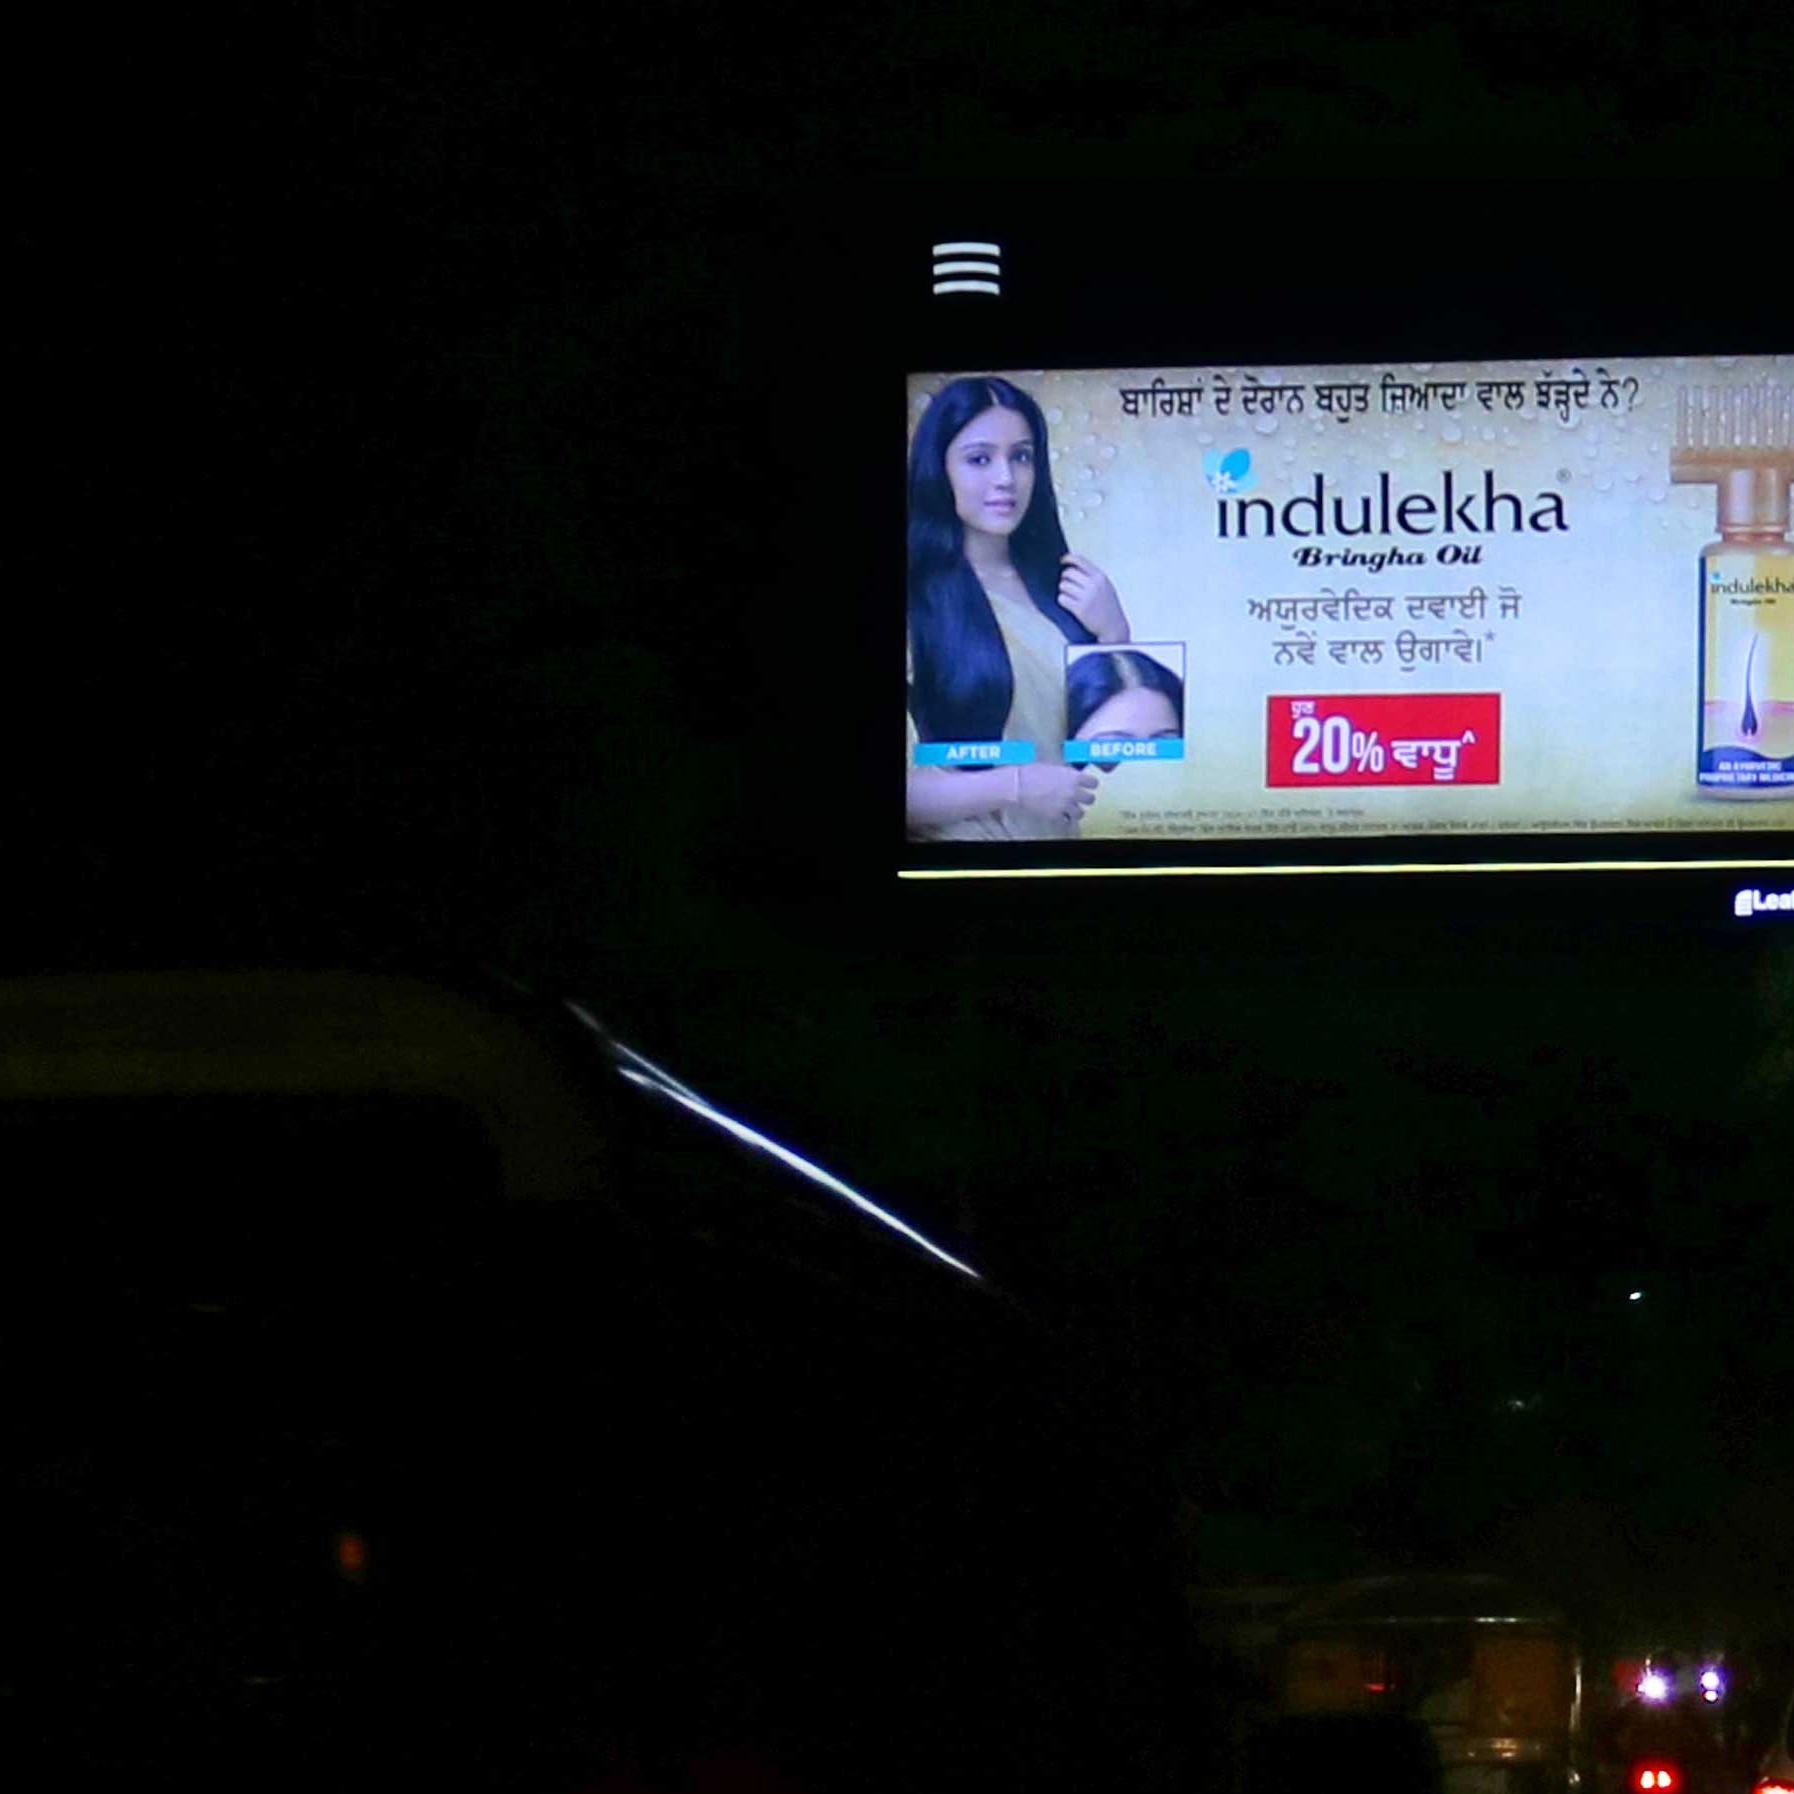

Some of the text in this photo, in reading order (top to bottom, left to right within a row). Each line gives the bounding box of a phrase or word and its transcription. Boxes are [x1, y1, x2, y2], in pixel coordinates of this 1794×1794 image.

[1212, 374, 1232, 415] ਦੇ
[1314, 384, 1371, 423] ਬਹੁਤ
[1475, 380, 1525, 411] ਵਾਲ
[1293, 544, 1483, 573] Bringha Oil
[1405, 586, 1487, 619] ਦਵਾਈ
[1498, 586, 1522, 619] ਜੋ
[1273, 630, 1316, 665] ਨਵੇਂ
[1328, 640, 1385, 664] ਵਾਲ
[946, 746, 1001, 760] AFTER
[1090, 742, 1157, 757] BEFORE
[1292, 716, 1385, 774] 20%
